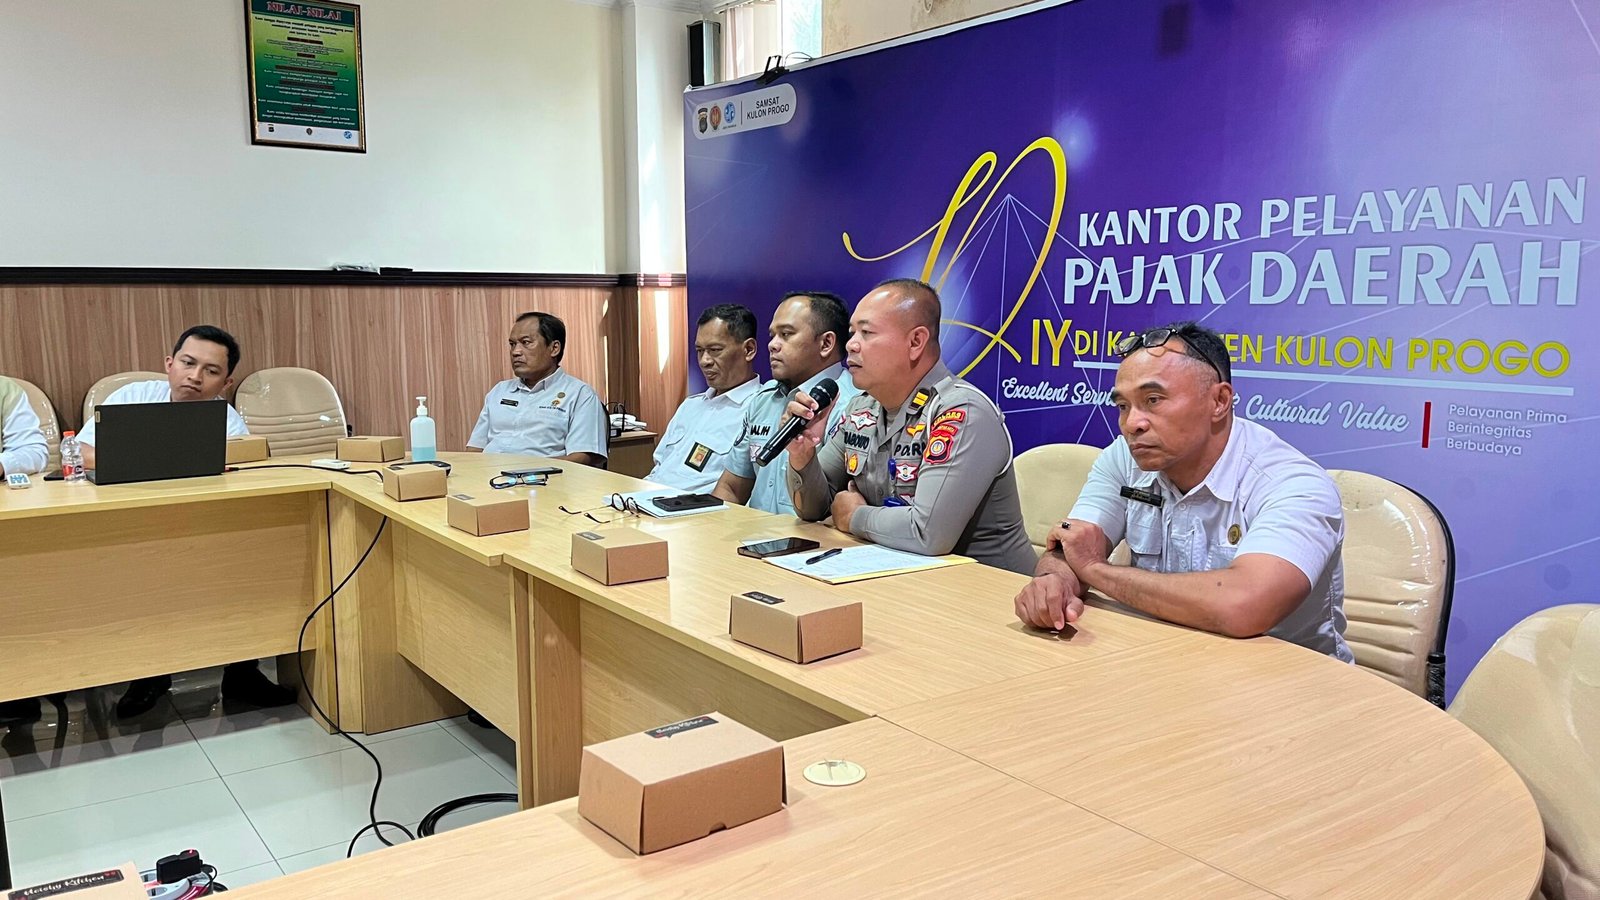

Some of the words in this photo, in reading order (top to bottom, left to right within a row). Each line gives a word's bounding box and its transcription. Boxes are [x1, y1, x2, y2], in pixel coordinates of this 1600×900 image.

[746, 108, 767, 120] KULON
[767, 103, 790, 116] PROGO
[756, 96, 780, 109] SAMSAT
[1078, 204, 1242, 247] KANTOR
[1260, 177, 1586, 238] PELAYANAN
[1063, 253, 1226, 305] PAJAK
[1248, 240, 1578, 306] DAERAH
[1074, 330, 1098, 356] DI
[1274, 335, 1394, 370] KULON
[1407, 338, 1570, 378] PROGO
[1002, 377, 1070, 401] Excellent
[1245, 394, 1332, 427] Cultural
[1338, 400, 1410, 433] Value
[1449, 404, 1522, 420] Pelayanan
[1526, 409, 1568, 424] Prima
[1448, 421, 1533, 439] Berintegritas
[1446, 437, 1522, 457] Berbudaya
